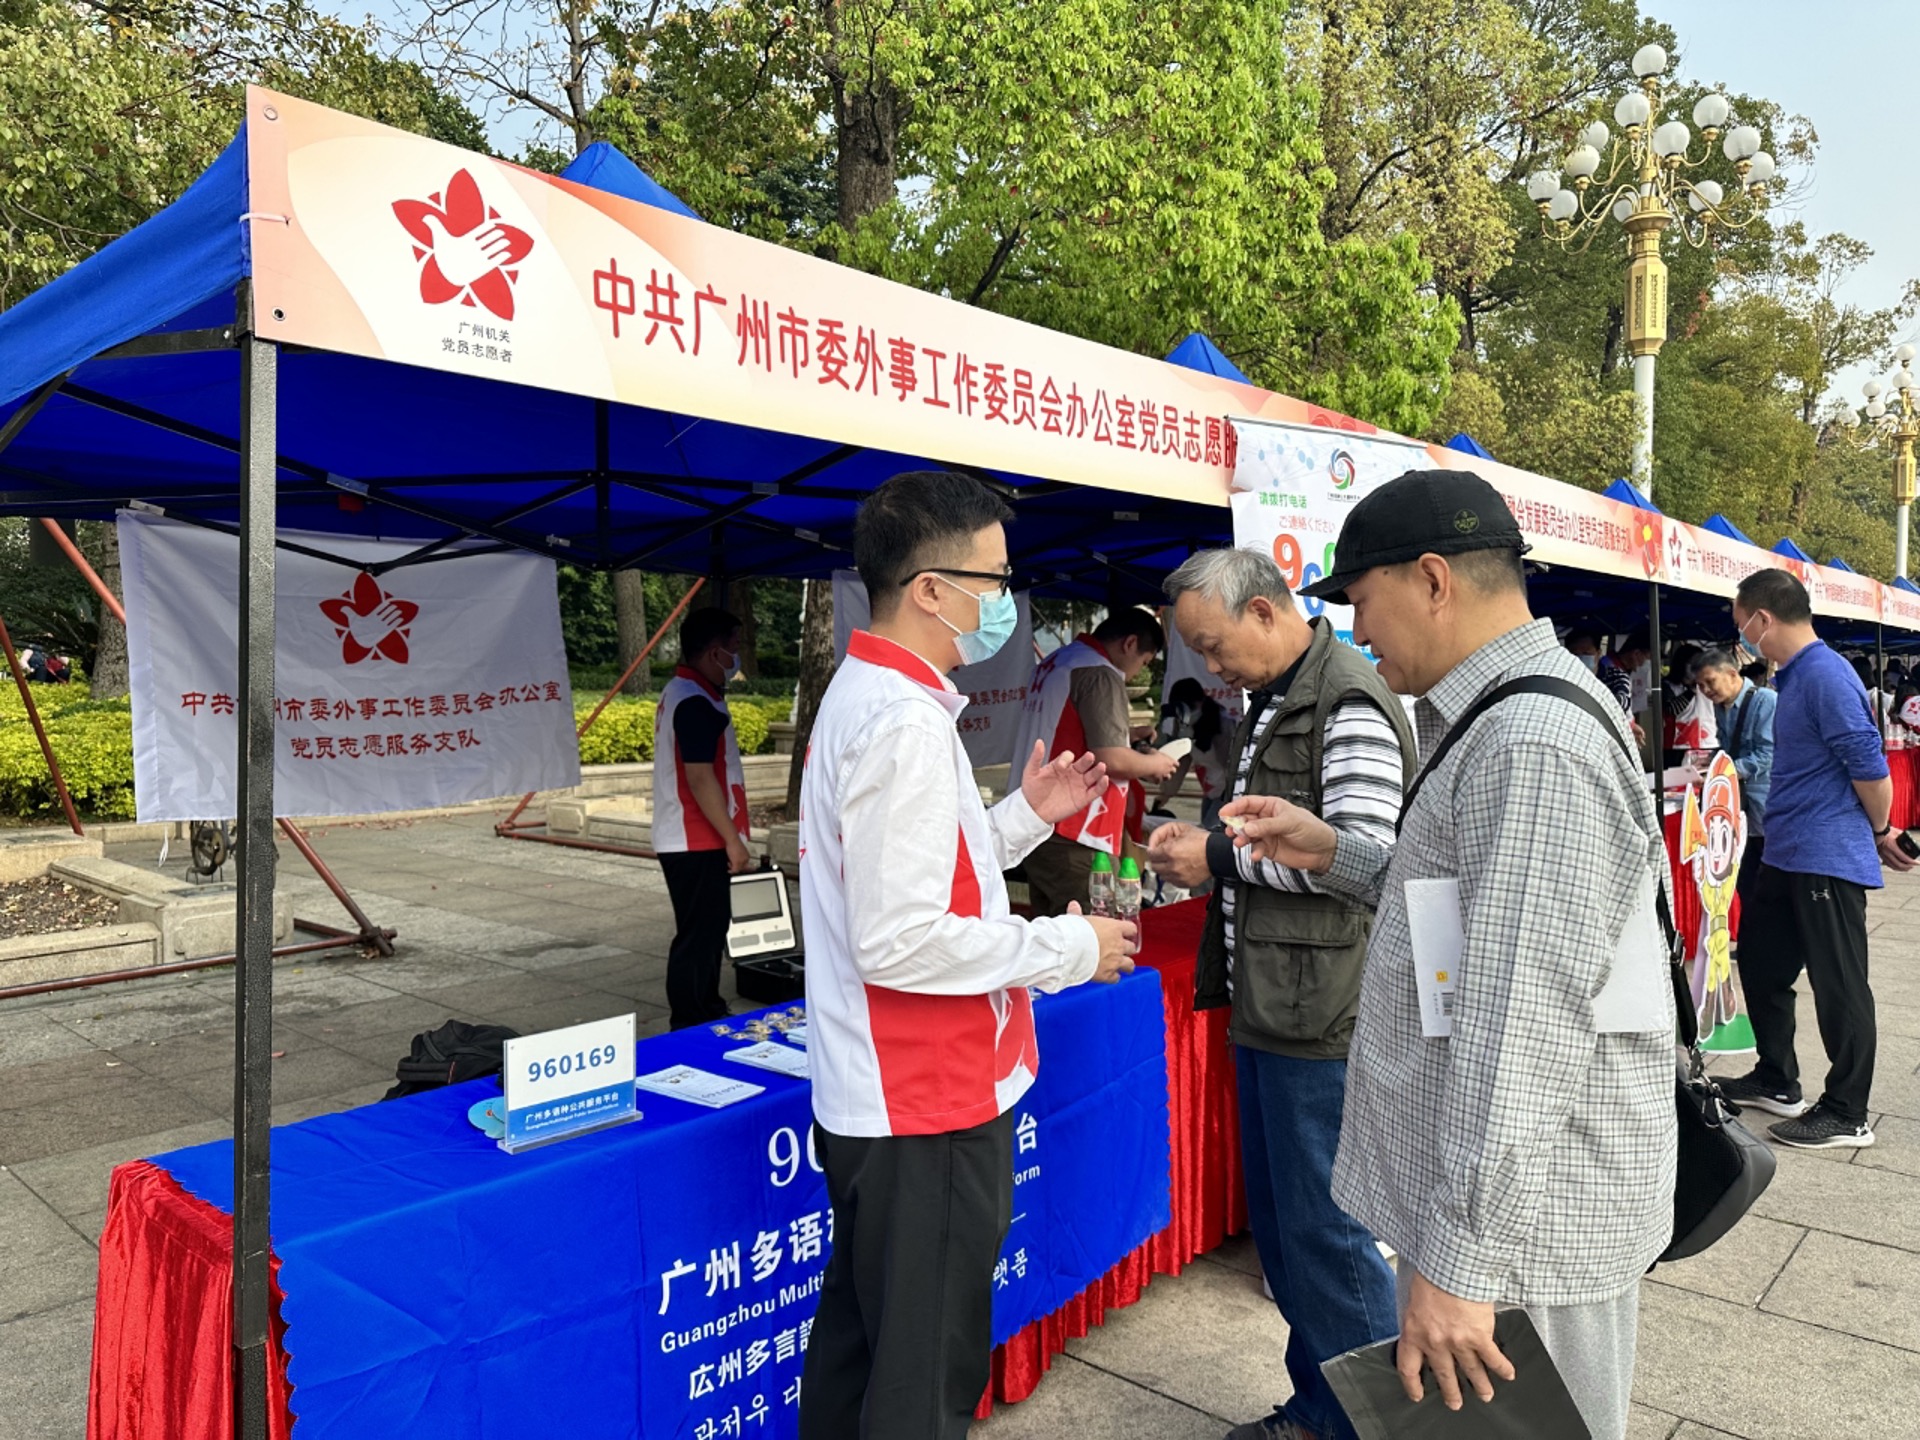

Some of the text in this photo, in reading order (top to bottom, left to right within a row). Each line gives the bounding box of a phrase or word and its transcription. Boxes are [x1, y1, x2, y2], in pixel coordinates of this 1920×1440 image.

[458, 321, 511, 343] 广州机关
[441, 337, 513, 363] 党员志愿者
[181, 681, 562, 721] 中共市委外事工作委员会办公室
[290, 728, 481, 760] 党员志愿服务支队
[528, 1044, 616, 1083] 960169
[525, 1092, 619, 1124] 广州多语种公共服务平台
[1016, 1112, 1038, 1155] 台
[661, 1298, 775, 1353] Guangzhou
[1012, 1164, 1041, 1186] orm
